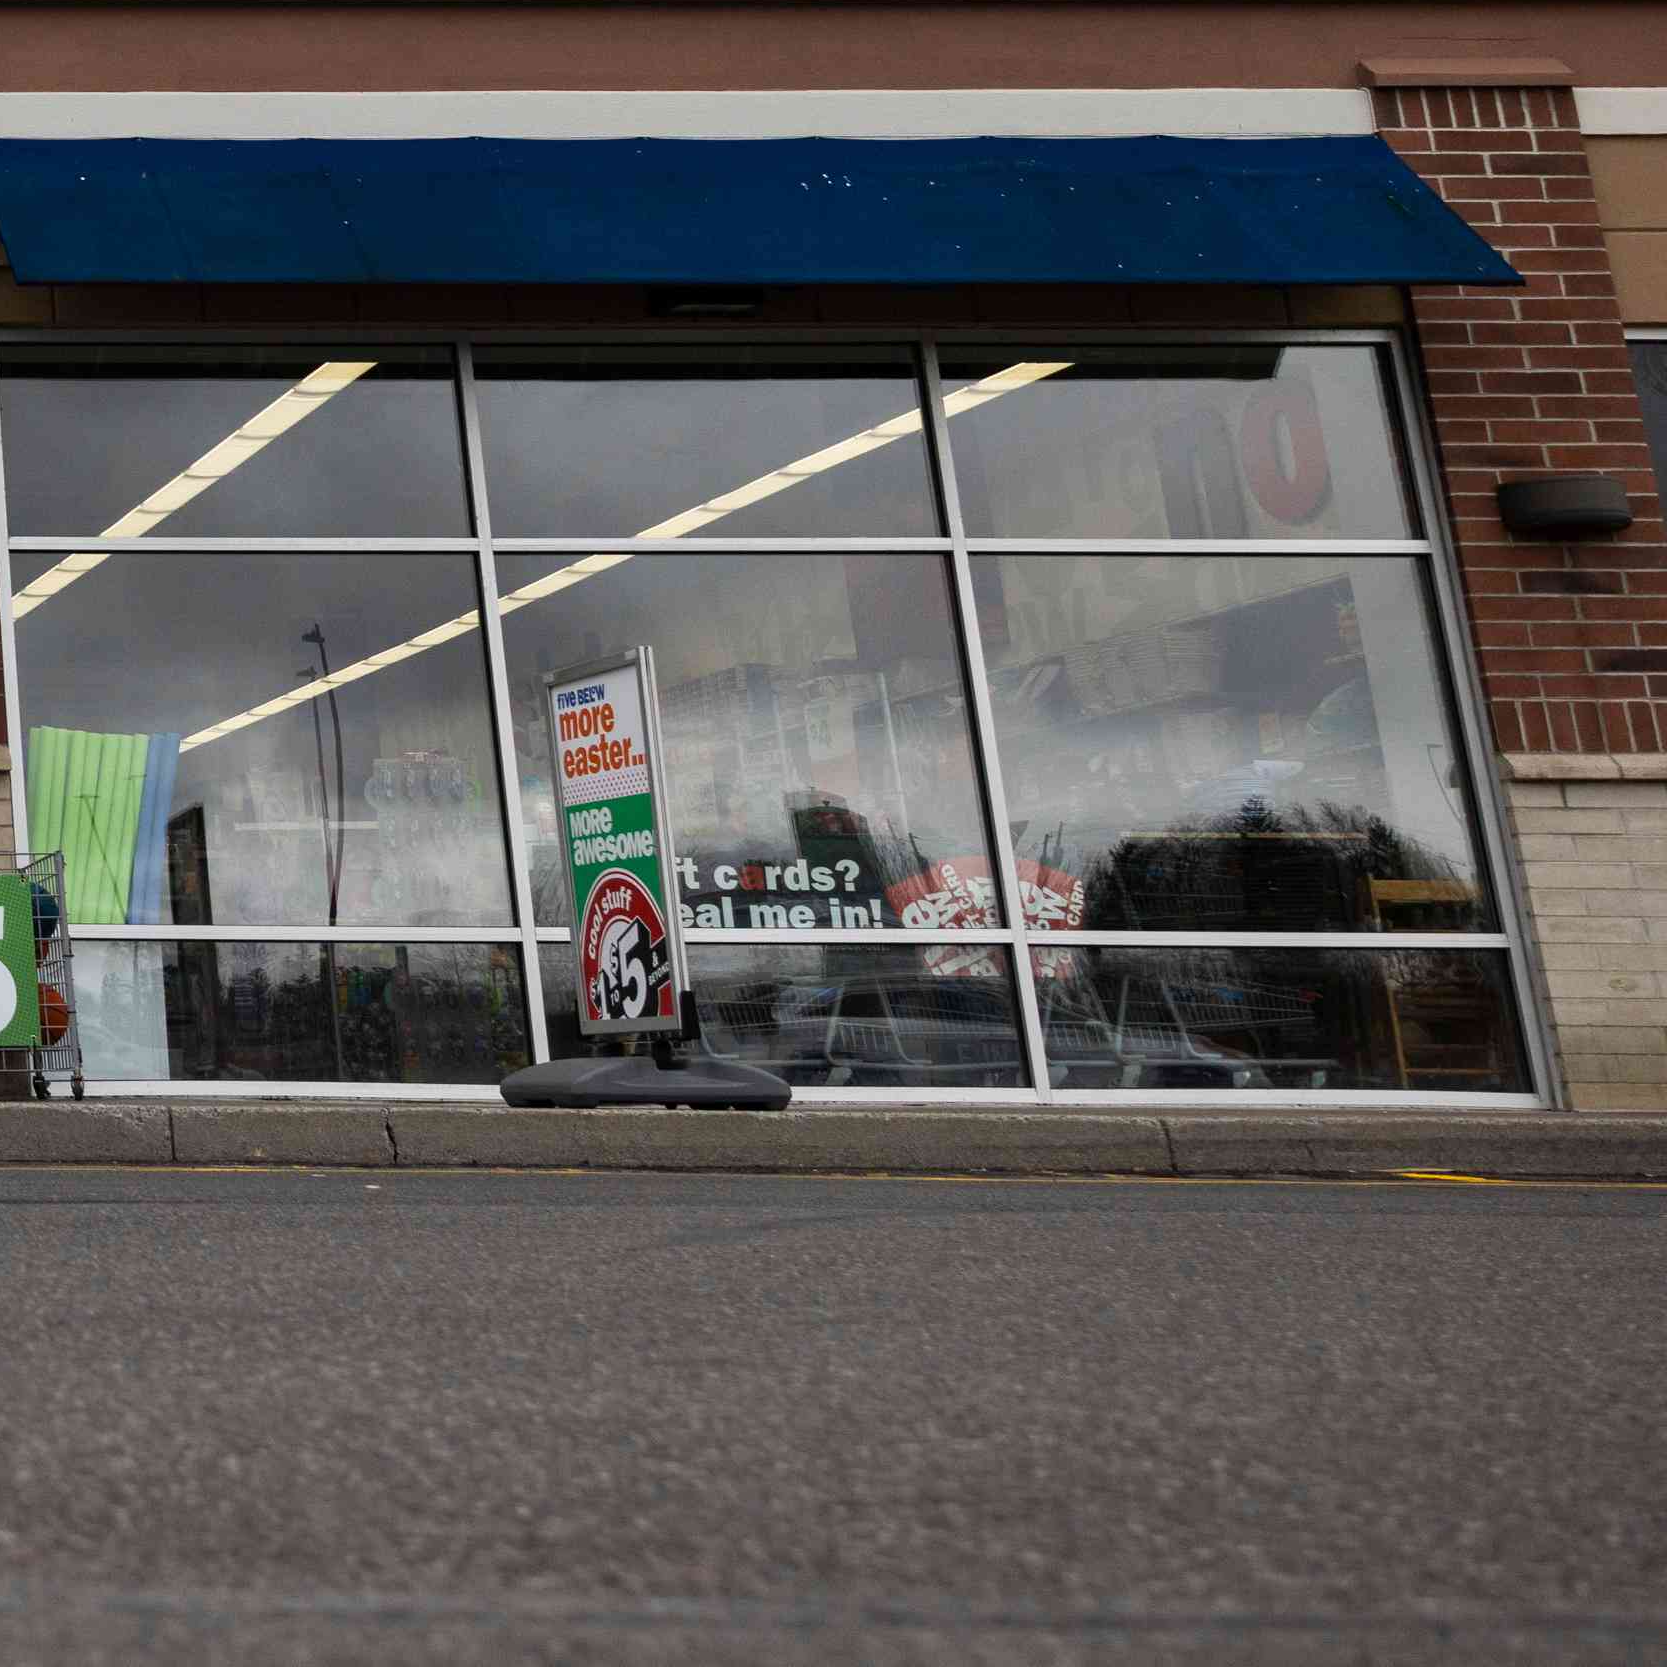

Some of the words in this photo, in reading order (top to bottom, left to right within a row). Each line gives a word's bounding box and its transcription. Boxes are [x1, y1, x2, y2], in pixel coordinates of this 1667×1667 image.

[557, 692, 577, 710] five
[578, 684, 605, 705] BELOW
[559, 703, 615, 742] more
[713, 859, 860, 892] cards?
[588, 903, 604, 960] cool
[601, 886, 634, 915] stuff
[679, 896, 734, 928] eal
[750, 903, 817, 928] me
[828, 897, 884, 928] in!
